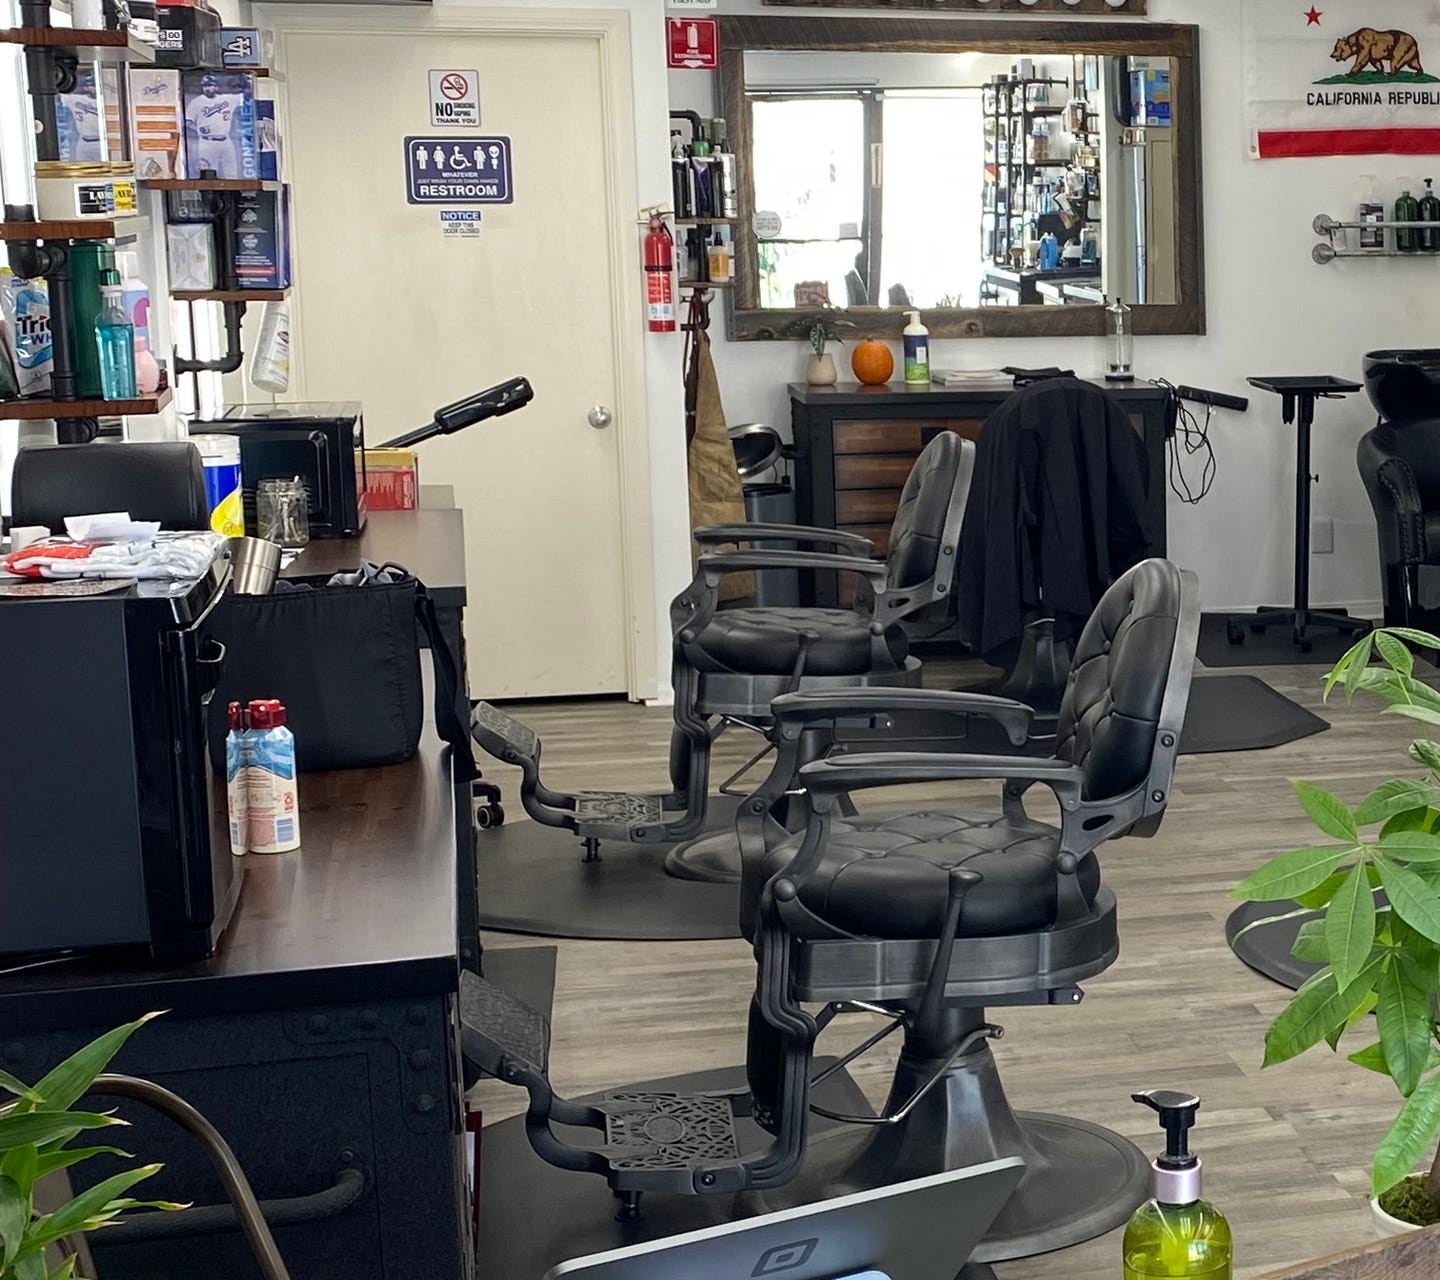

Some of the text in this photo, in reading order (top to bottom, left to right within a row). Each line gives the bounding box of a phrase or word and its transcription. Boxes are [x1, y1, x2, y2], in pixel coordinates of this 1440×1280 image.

[1307, 91, 1382, 105] CALIFORNIA
[435, 103, 453, 116] NO
[420, 185, 497, 196] RESTROOM
[442, 212, 479, 220] NOTICE
